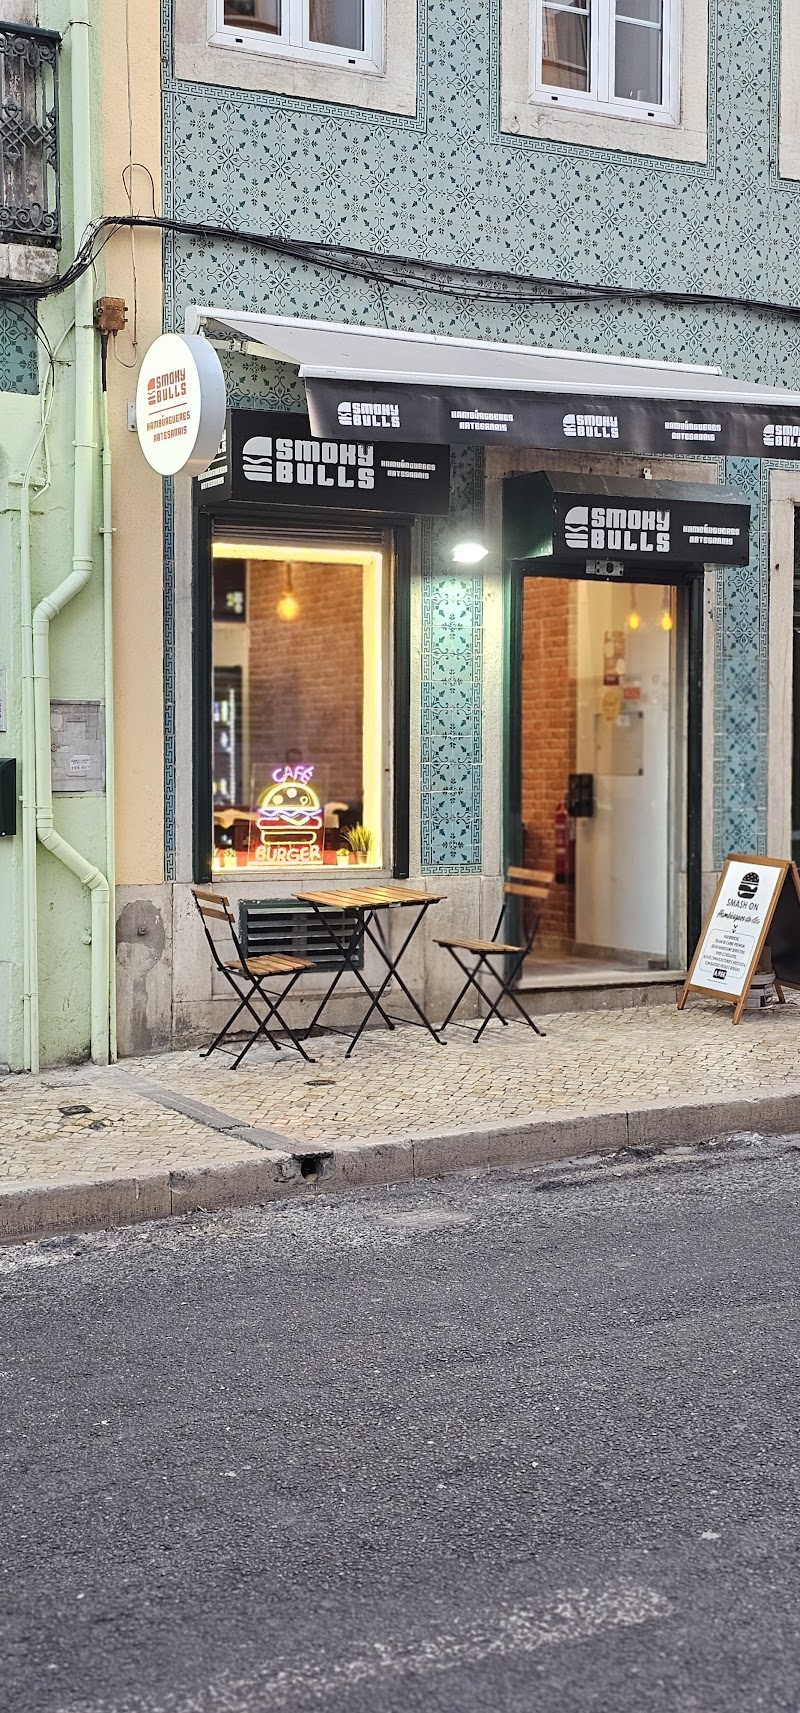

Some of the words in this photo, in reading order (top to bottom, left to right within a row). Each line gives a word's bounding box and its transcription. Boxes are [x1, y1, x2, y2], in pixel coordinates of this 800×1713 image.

[156, 368, 186, 389] SMOKY
[156, 382, 187, 403] BULLS
[352, 402, 399, 416] SMOKY
[351, 414, 401, 428] BULLS
[459, 421, 508, 432] ARTESANAIS
[576, 414, 618, 428] SMOKY
[153, 426, 188, 442] ARTESANAIS
[576, 426, 619, 439] BULLS
[775, 424, 800, 436] SMO
[275, 438, 374, 467] SMOKY
[275, 461, 375, 490] BULLS
[591, 507, 670, 531] SMOKY
[590, 528, 670, 553] BULLS
[272, 765, 314, 785] CAFÉ
[255, 844, 321, 862] BURGER
[726, 898, 748, 910] SMASH
[748, 902, 760, 911] ON
